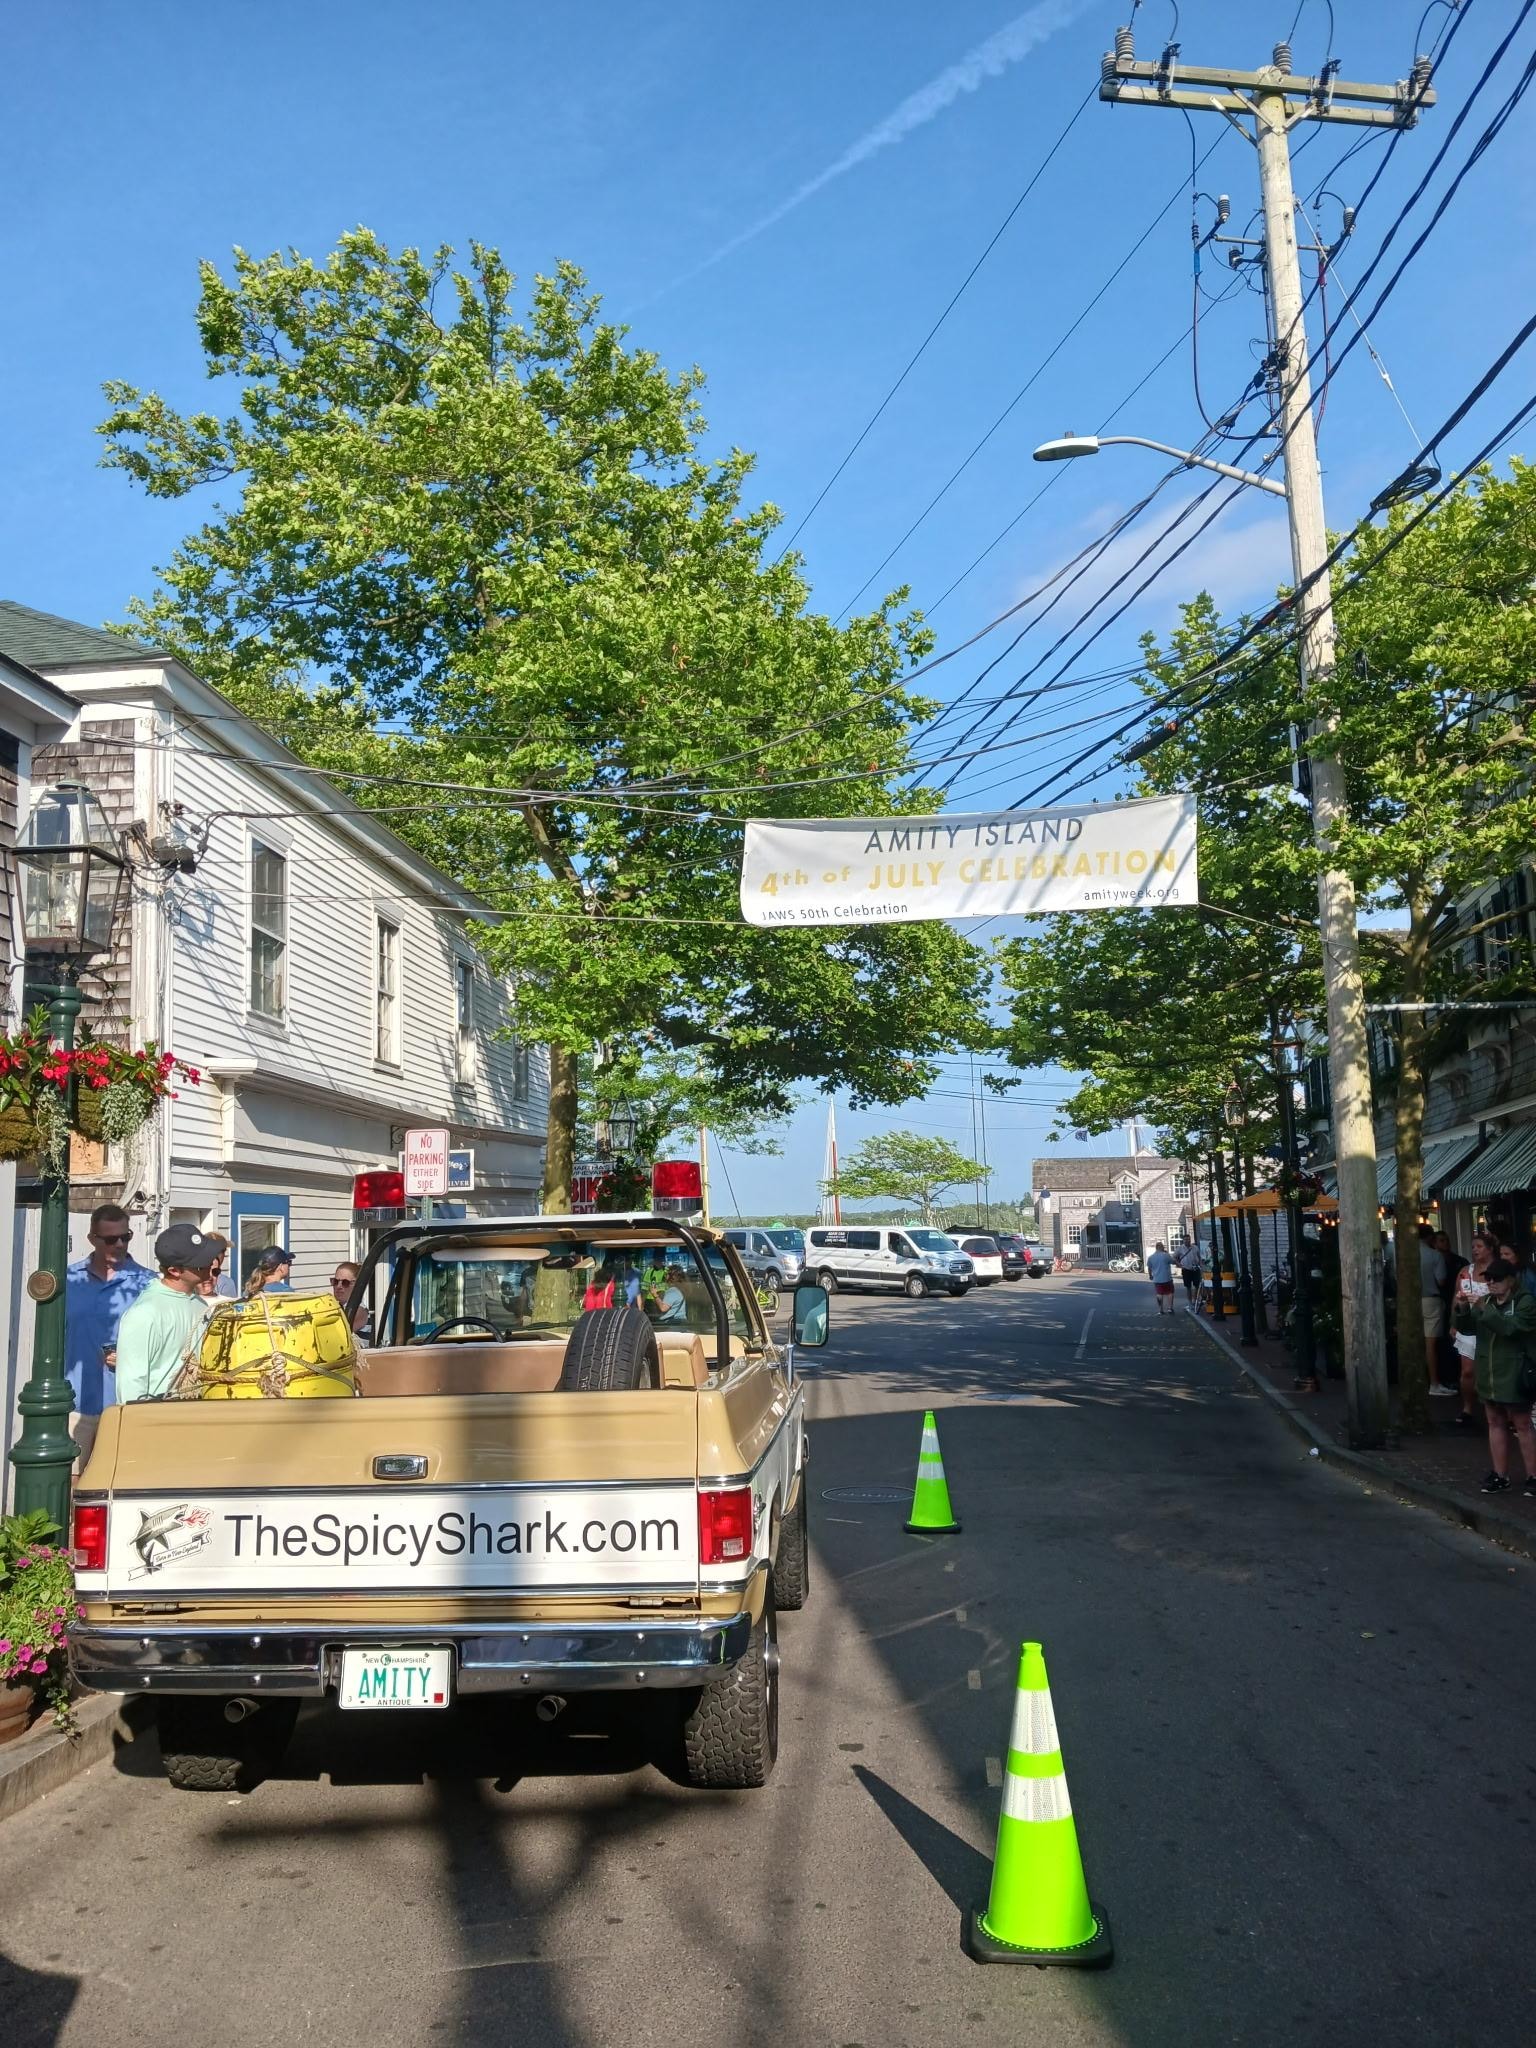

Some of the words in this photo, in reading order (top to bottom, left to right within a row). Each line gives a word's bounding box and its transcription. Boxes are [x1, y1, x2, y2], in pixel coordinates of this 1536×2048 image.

[864, 824, 961, 854] AMITY
[974, 818, 1083, 847] ISLAND
[760, 868, 809, 897] 4th
[822, 865, 851, 884] of
[868, 861, 945, 890] JULY
[958, 848, 1176, 884] CELEBRATION
[1084, 887, 1180, 902] amityweek.org
[762, 908, 796, 921] JAWS
[800, 906, 829, 919] 50th
[834, 903, 908, 917] Celebration
[420, 1136, 433, 1149] NO
[408, 1153, 444, 1166] PARKING
[413, 1168, 439, 1177] EITHER
[417, 1180, 434, 1189] SIDE
[571, 1177, 602, 1202] BIK
[224, 1510, 680, 1567] TheSpicyShark.com
[358, 1667, 431, 1699] AMITY
